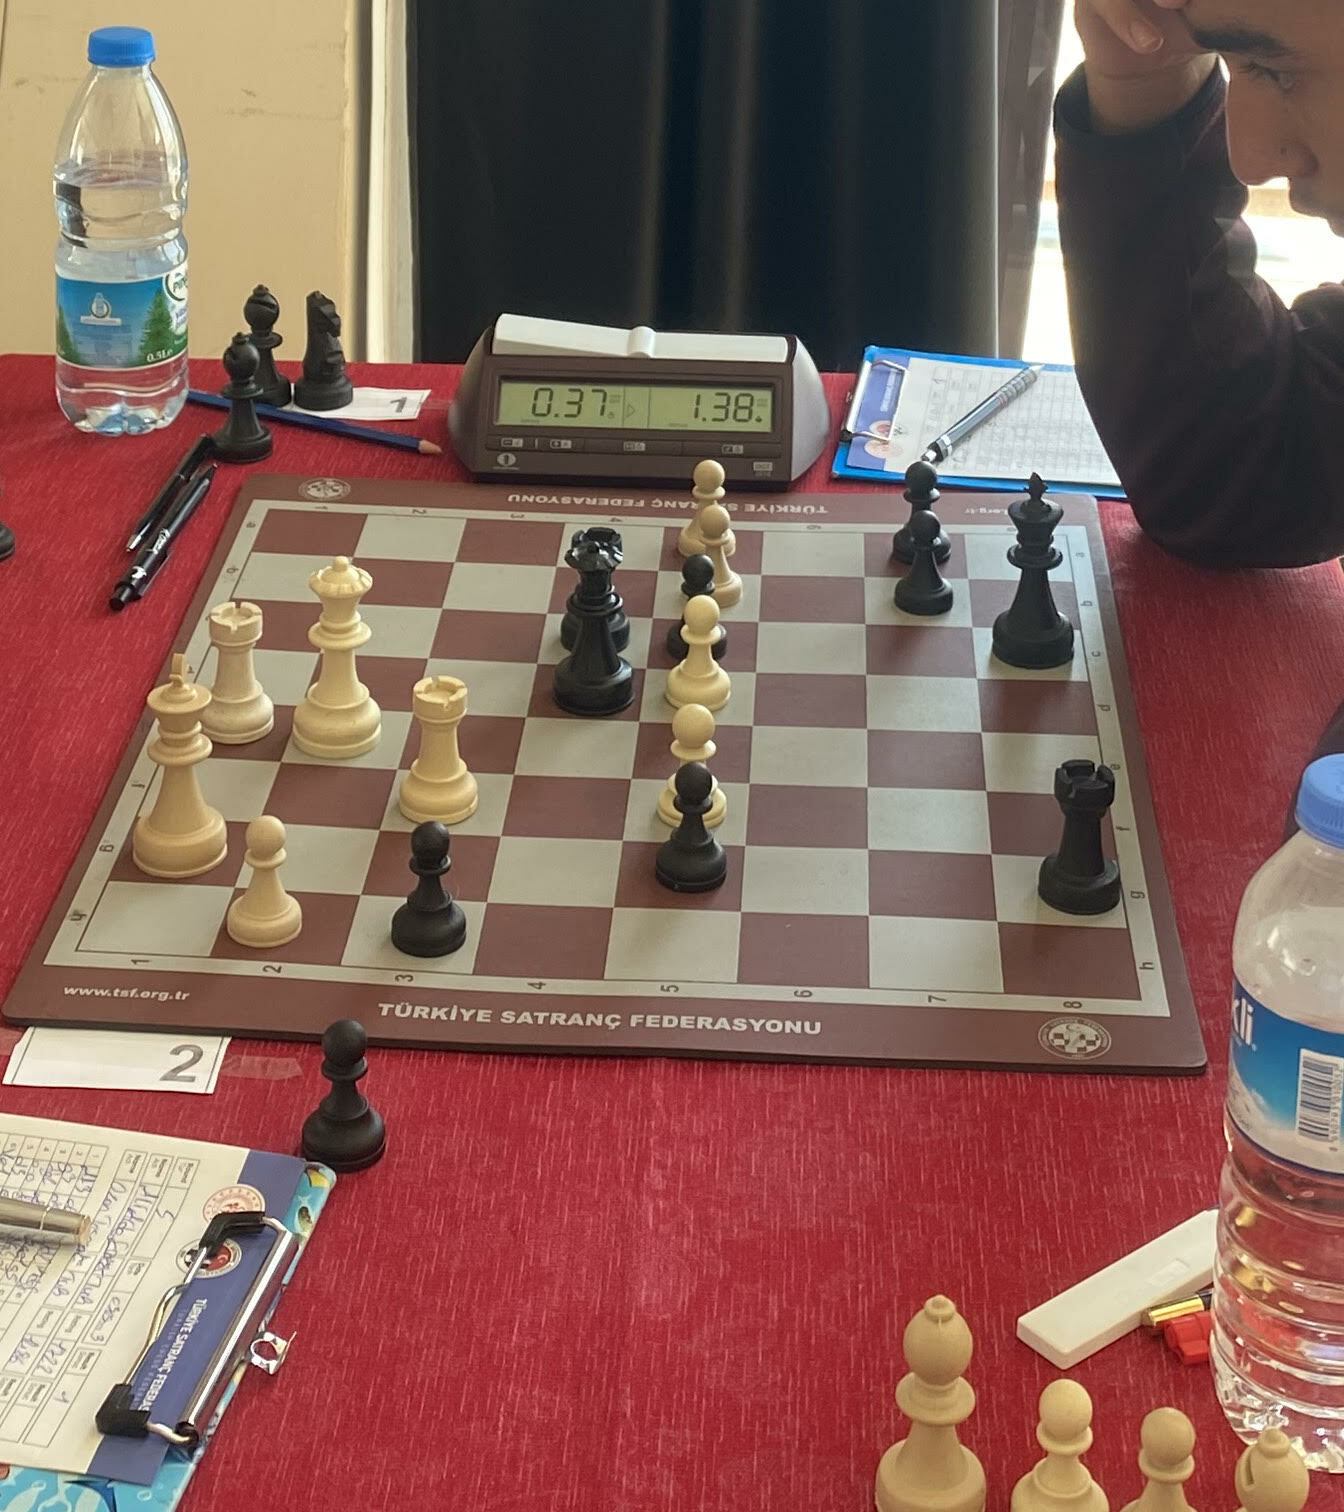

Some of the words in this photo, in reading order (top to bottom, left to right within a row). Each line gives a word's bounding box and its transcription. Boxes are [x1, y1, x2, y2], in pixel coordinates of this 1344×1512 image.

[390, 396, 408, 414] 1
[531, 387, 608, 419] 0.37
[507, 493, 645, 508] FEDERASYONU
[744, 502, 829, 515] TÜRKİYE
[263, 964, 282, 974] 2
[395, 973, 414, 983] 3
[63, 985, 191, 1002] www.tsf.org.tr
[532, 981, 547, 991] 4
[660, 984, 680, 993] 5
[928, 995, 947, 1004] 7
[1063, 1000, 1083, 1010] 8
[377, 1001, 492, 1024] TÜRKİYE
[500, 1009, 623, 1030] SATRANÇ
[630, 1014, 823, 1035] FEDERASYONU
[159, 1044, 204, 1083] 2
[180, 1298, 208, 1333] TÜRKİYE
[159, 1334, 191, 1373] SATRANÇ
